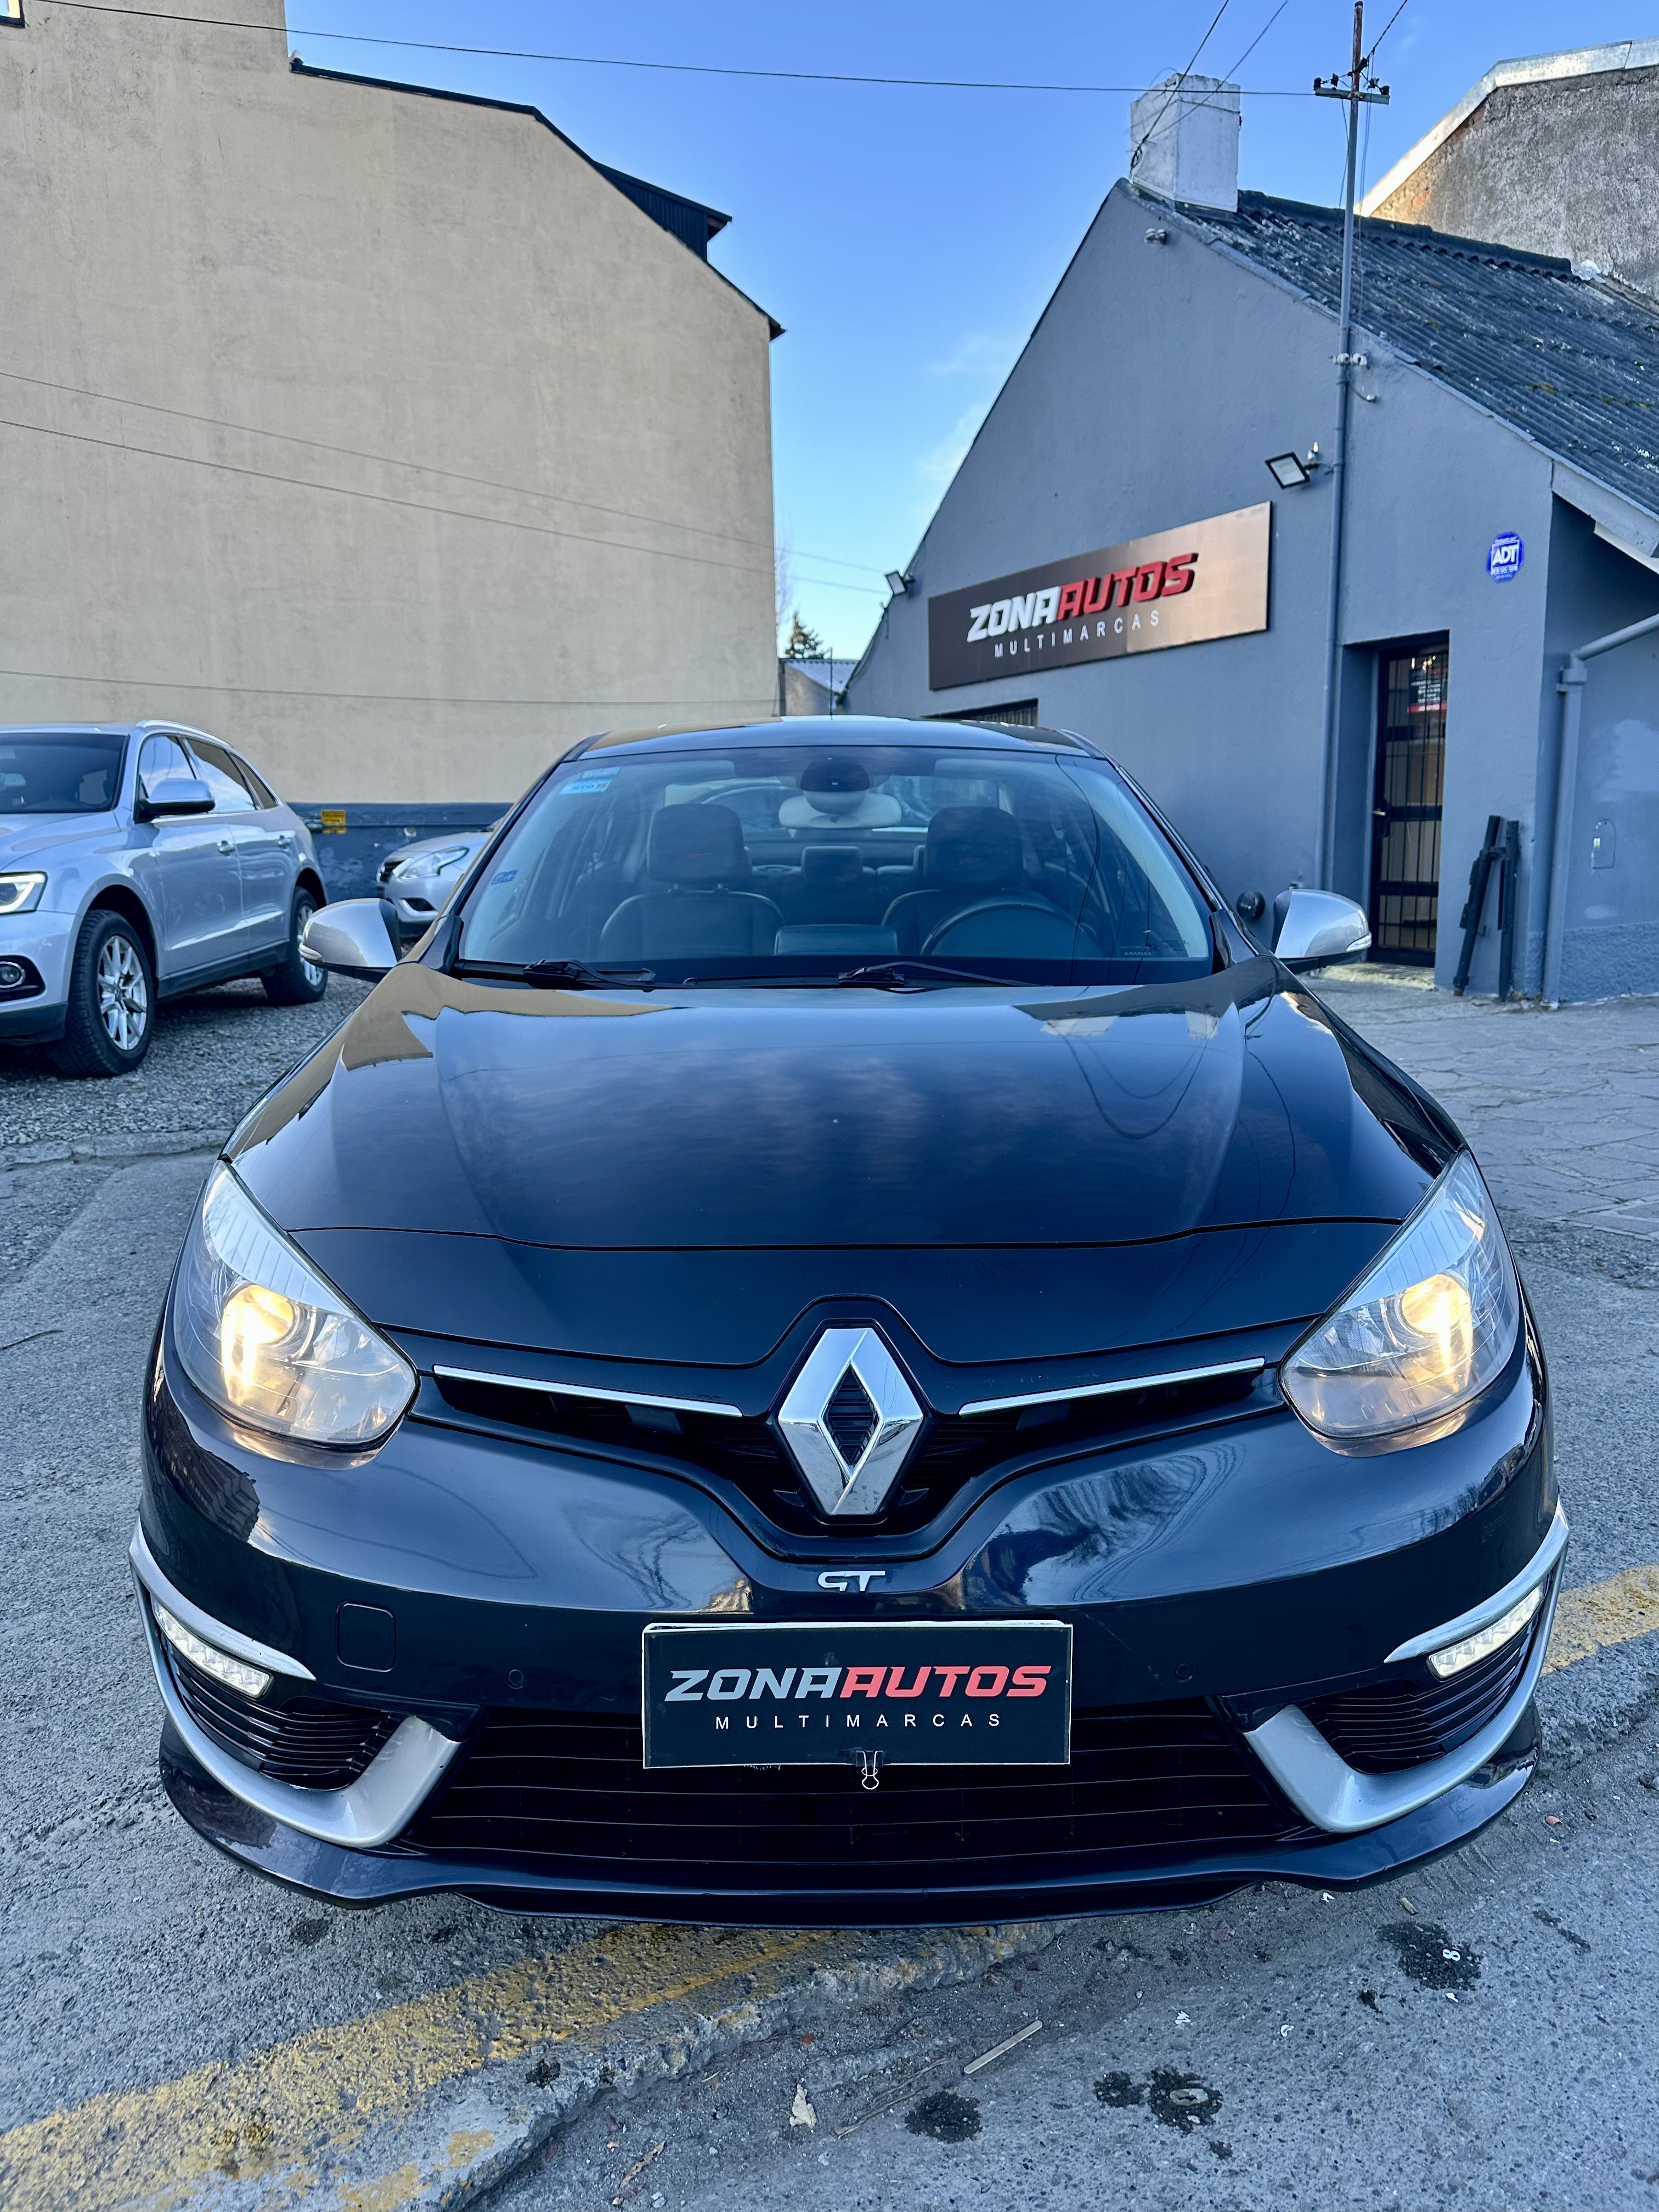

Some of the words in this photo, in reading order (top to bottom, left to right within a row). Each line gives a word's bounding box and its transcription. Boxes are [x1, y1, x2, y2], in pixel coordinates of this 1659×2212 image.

[1492, 545, 1519, 565] ADT
[995, 610, 1159, 658] MULTIMARCAS
[818, 1571, 885, 1592] GT
[716, 1714, 1000, 1729] MULTIMARCAS
